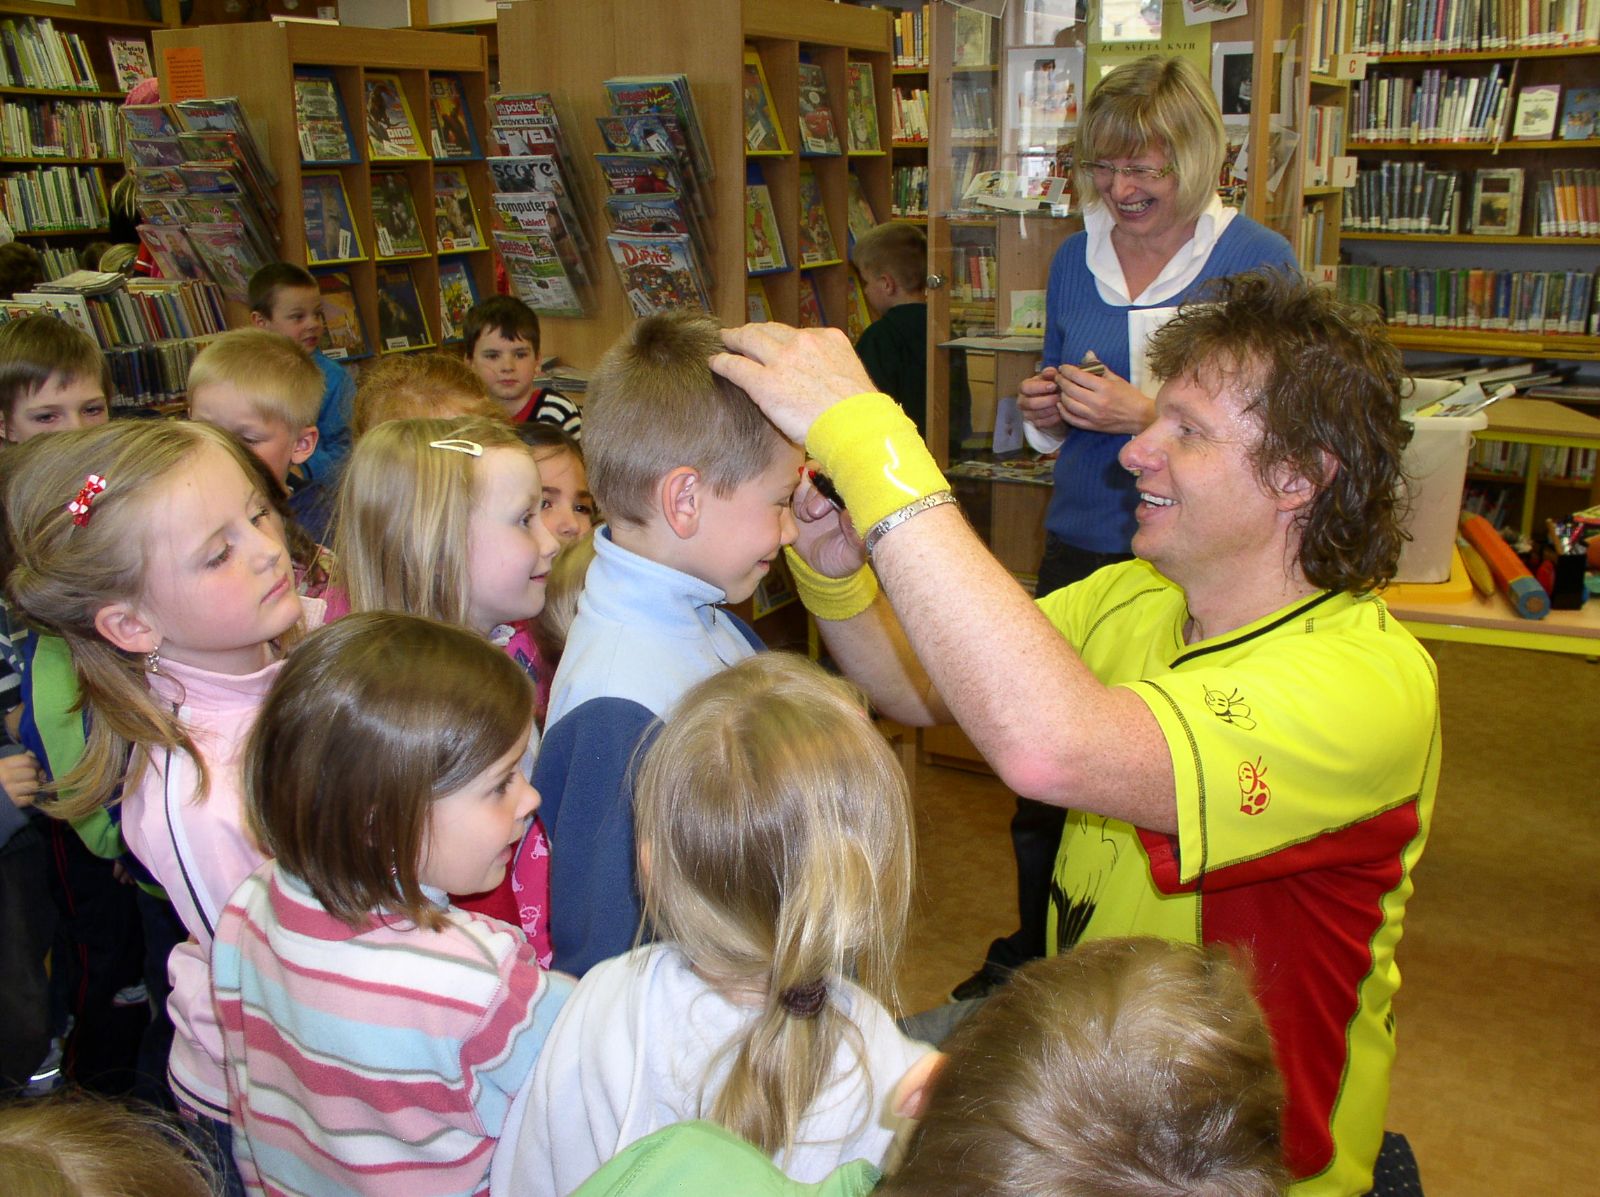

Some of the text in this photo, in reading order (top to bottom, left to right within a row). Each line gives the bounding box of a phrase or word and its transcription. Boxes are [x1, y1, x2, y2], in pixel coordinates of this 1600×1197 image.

[1167, 42, 1196, 50] KNIH
[1349, 59, 1356, 74] C
[497, 200, 547, 214] computer
[1324, 269, 1333, 281] M
